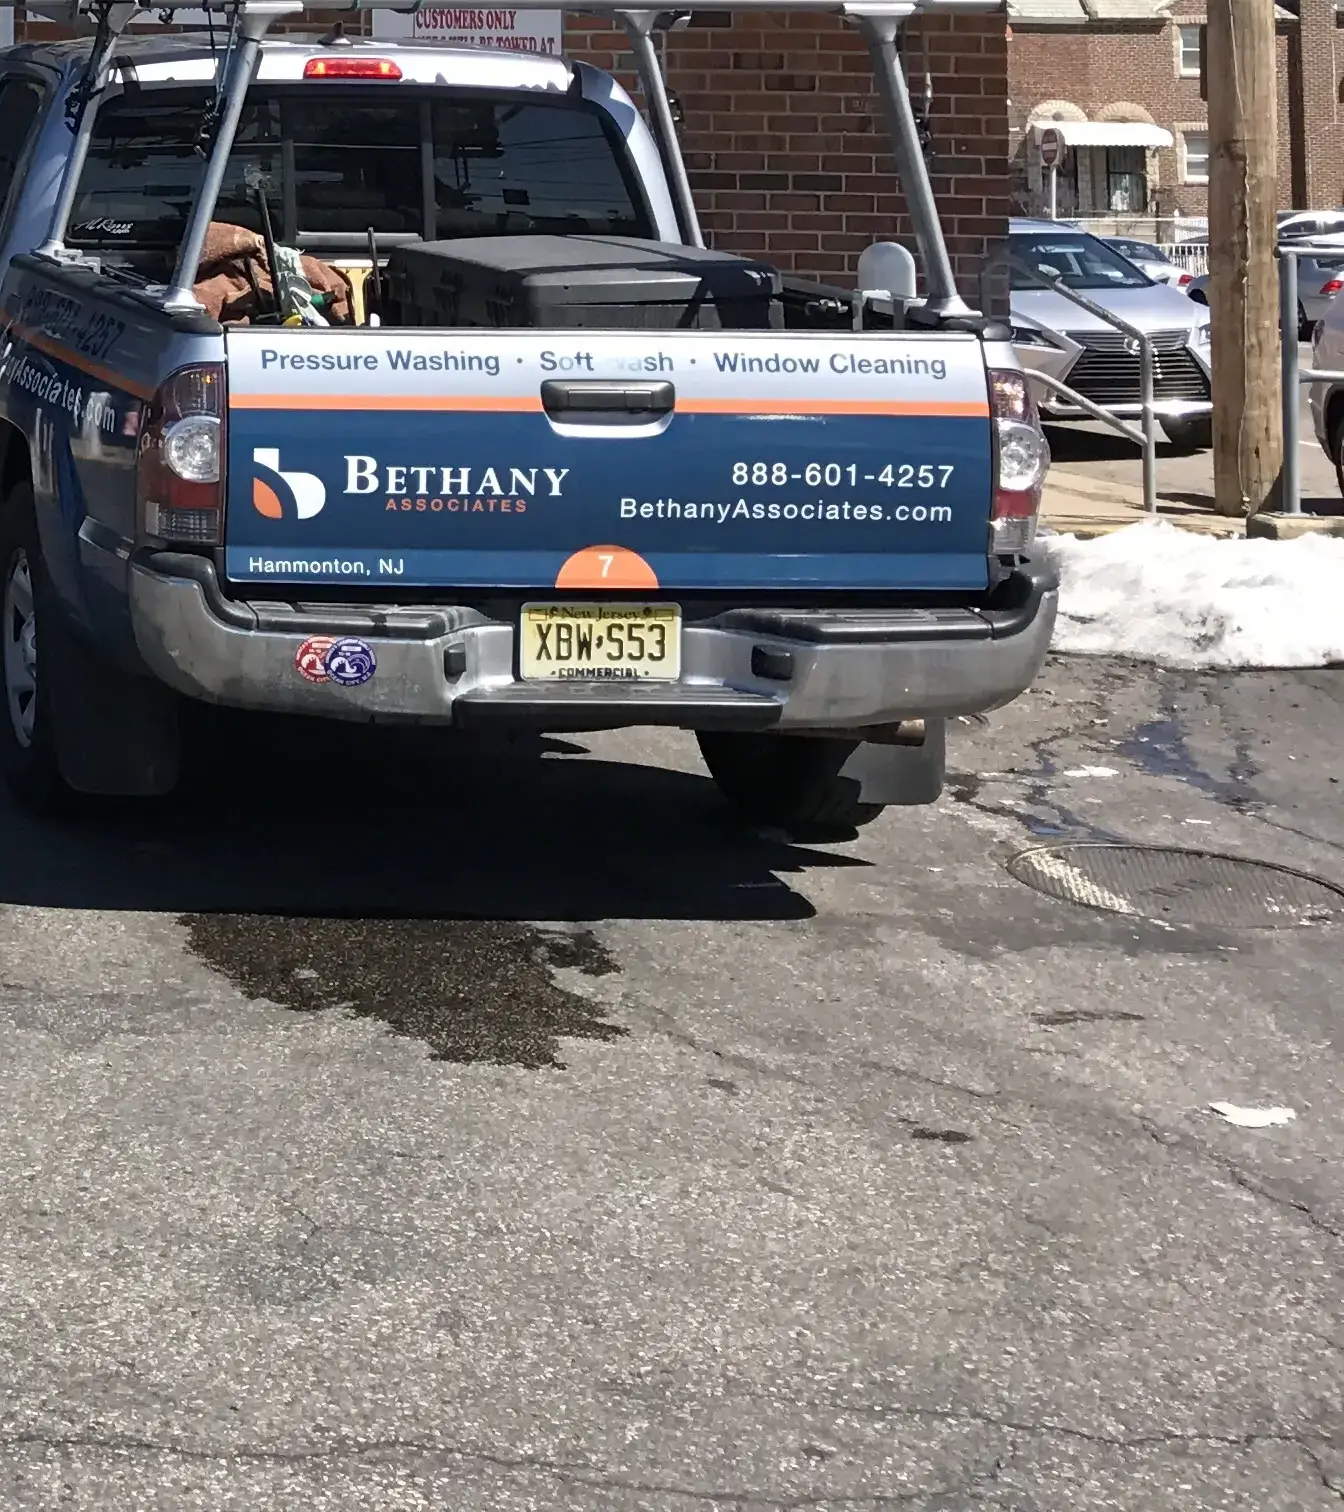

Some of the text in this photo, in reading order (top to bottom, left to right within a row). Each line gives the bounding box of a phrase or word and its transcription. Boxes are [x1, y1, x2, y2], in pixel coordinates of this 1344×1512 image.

[416, 8, 517, 30] CUSTOMERS ONLY
[261, 349, 378, 371] Pressure
[385, 350, 500, 377] Washing
[615, 352, 674, 372] ash
[713, 352, 820, 375] Window
[829, 353, 947, 380] Cleaning
[343, 455, 955, 497] BETHANY 888-601-4257
[385, 498, 527, 513] ASSOCIATES
[620, 498, 953, 524] BethanyAssociates.com
[249, 557, 405, 577] Hammonton, NJ
[598, 555, 614, 578] 7
[562, 607, 640, 622] New Jersey
[558, 667, 641, 679] COMMERCIAL
